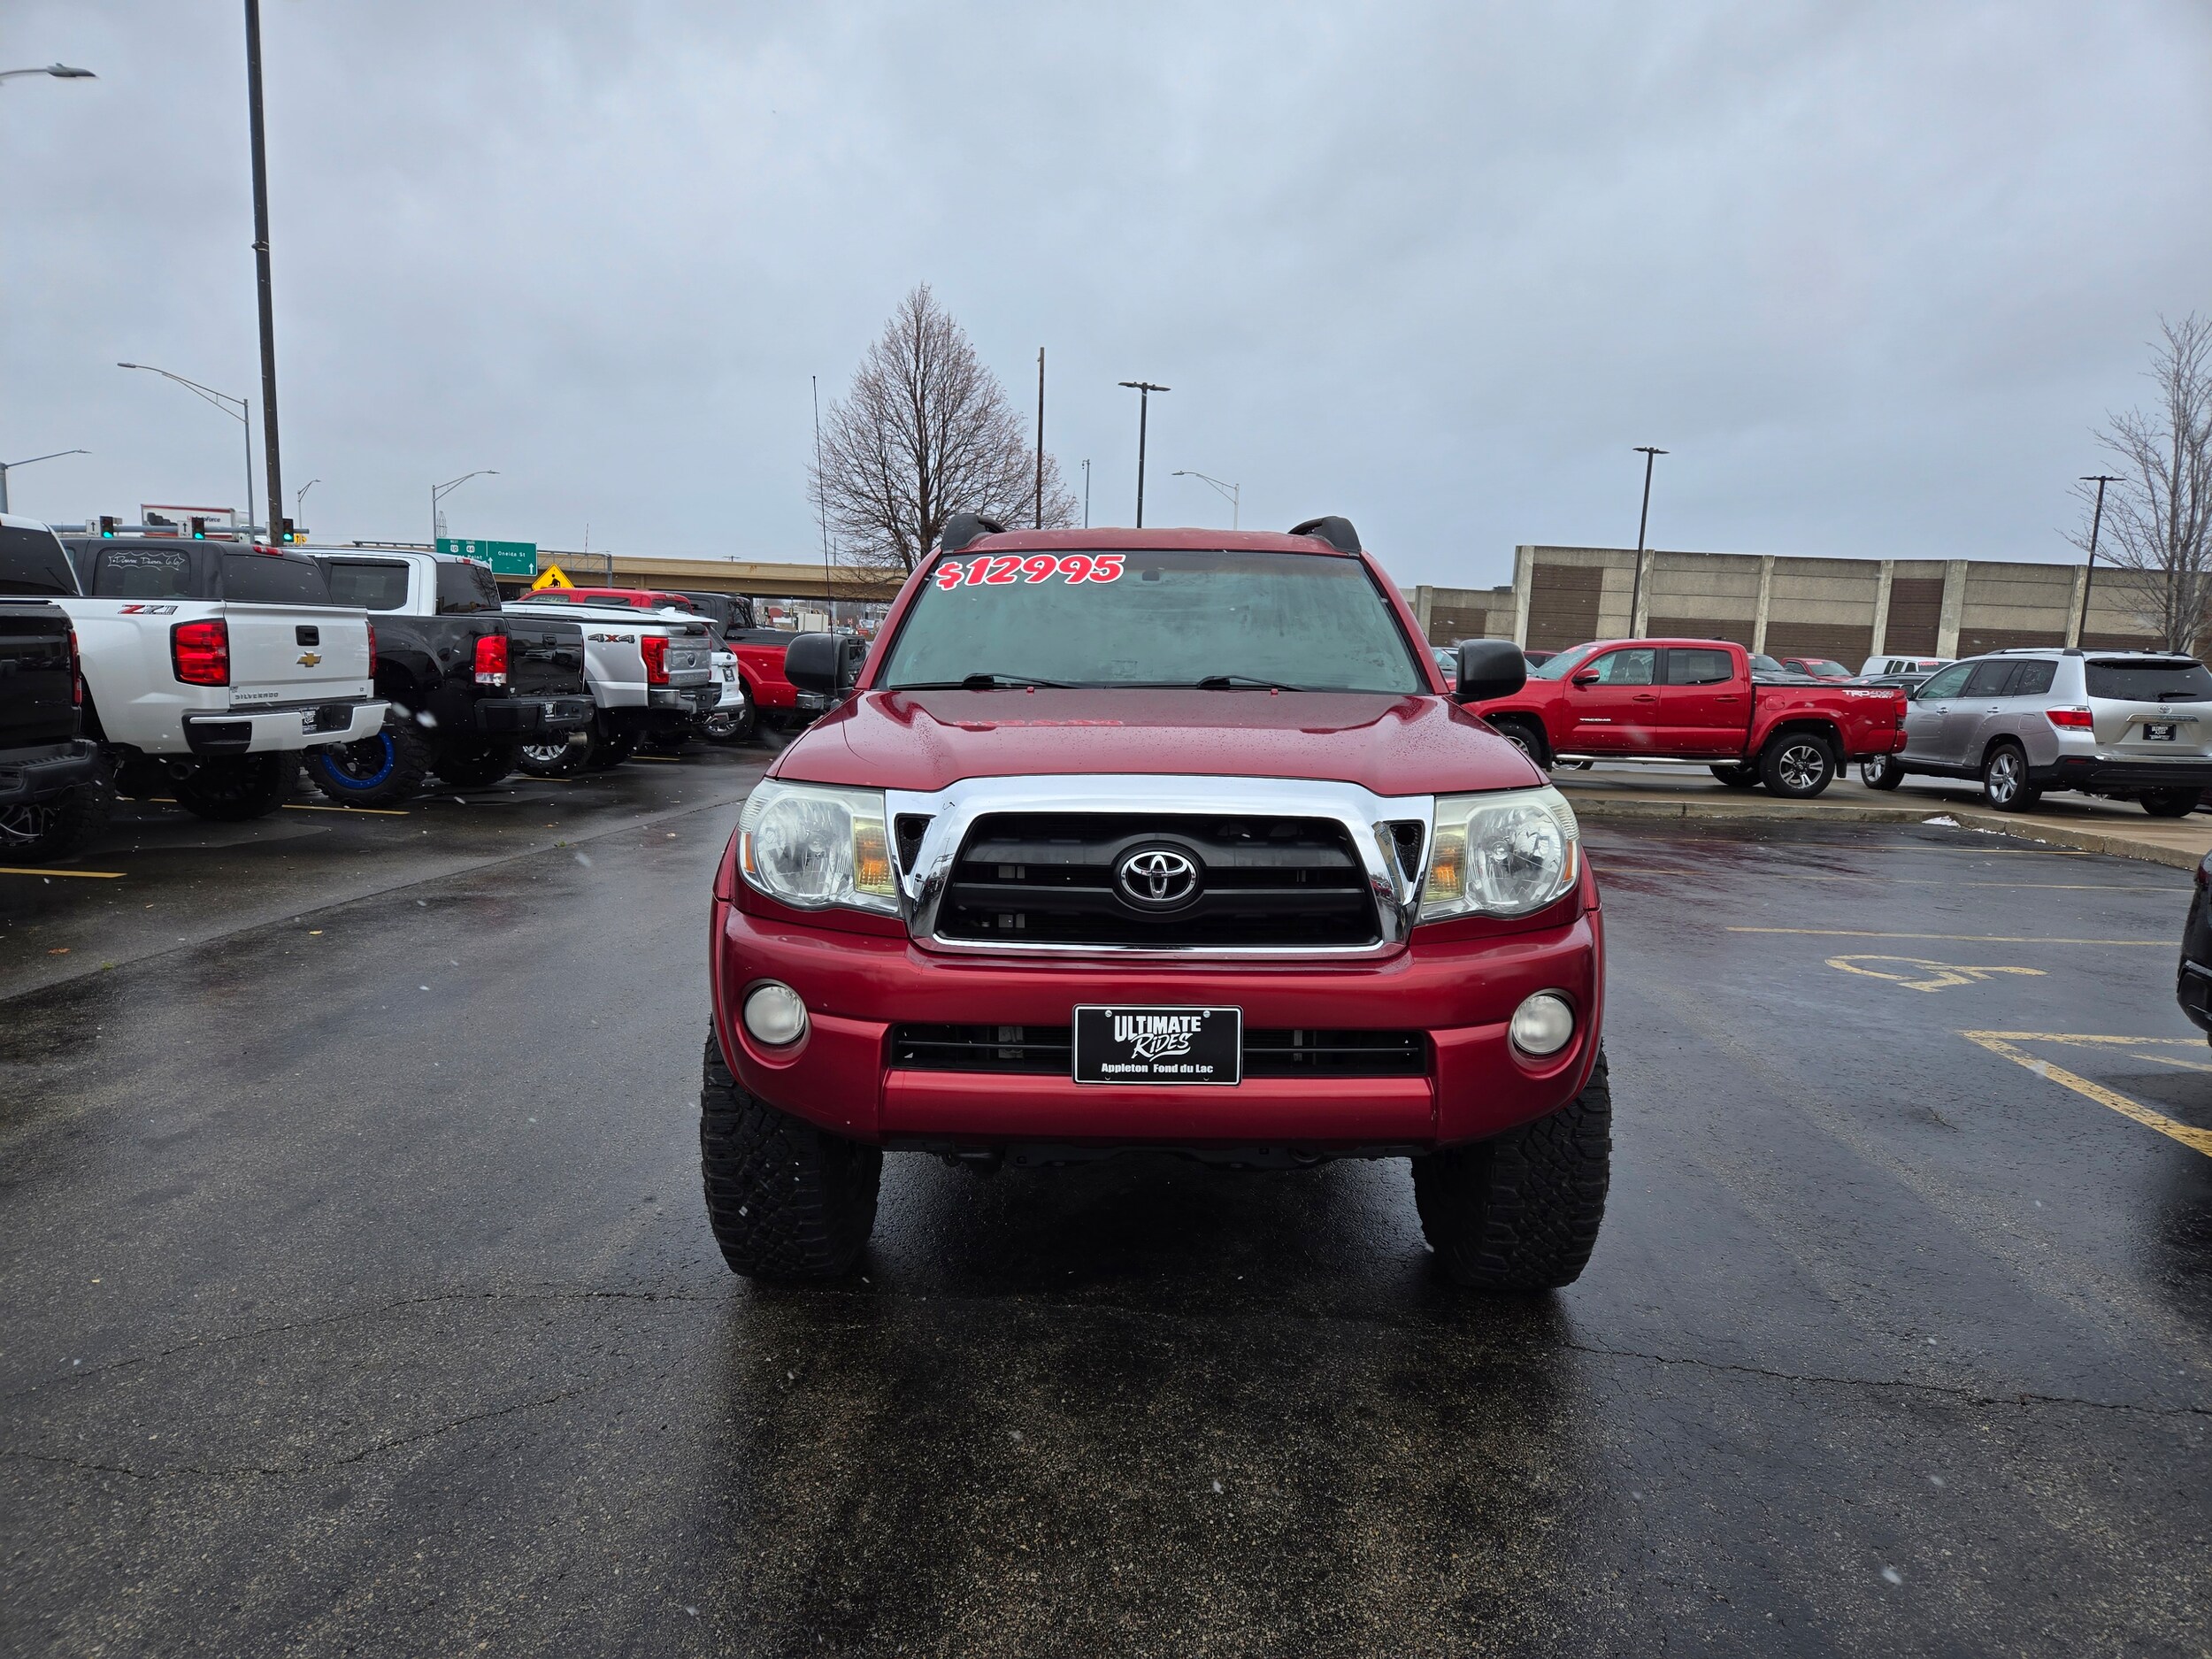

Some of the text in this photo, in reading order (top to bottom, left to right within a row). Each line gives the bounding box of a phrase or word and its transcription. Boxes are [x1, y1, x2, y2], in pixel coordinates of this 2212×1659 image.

[935, 554, 1126, 591] $12995
[117, 603, 179, 615] Z71
[1114, 1015, 1202, 1042] ULTIMATE
[1101, 1063, 1214, 1073] Appleton Fond du Lac
